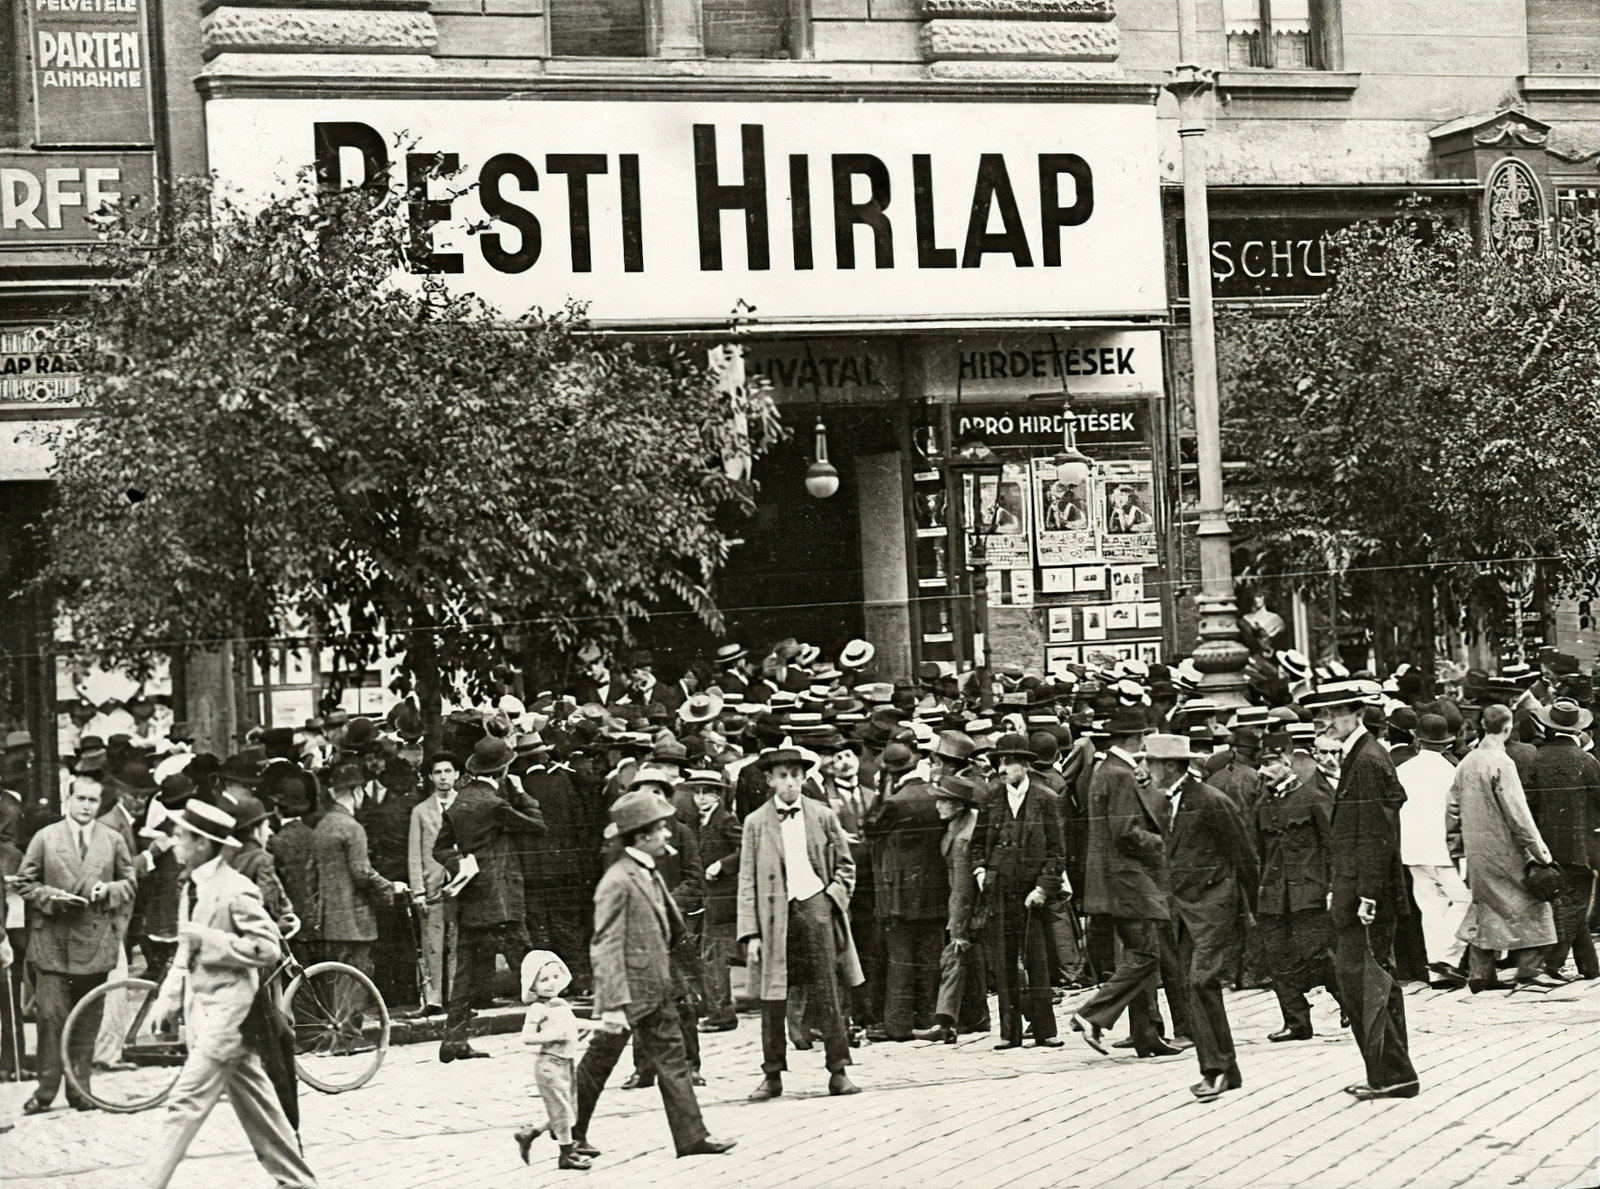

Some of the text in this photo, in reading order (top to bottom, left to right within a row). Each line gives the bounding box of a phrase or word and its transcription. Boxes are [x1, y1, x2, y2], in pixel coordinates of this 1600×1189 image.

[38, 31, 140, 68] PARTEN
[314, 122, 1094, 274] PESTI HIRLAP
[0, 356, 32, 374] AP
[959, 342, 1136, 379] HIRDETÉSEK
